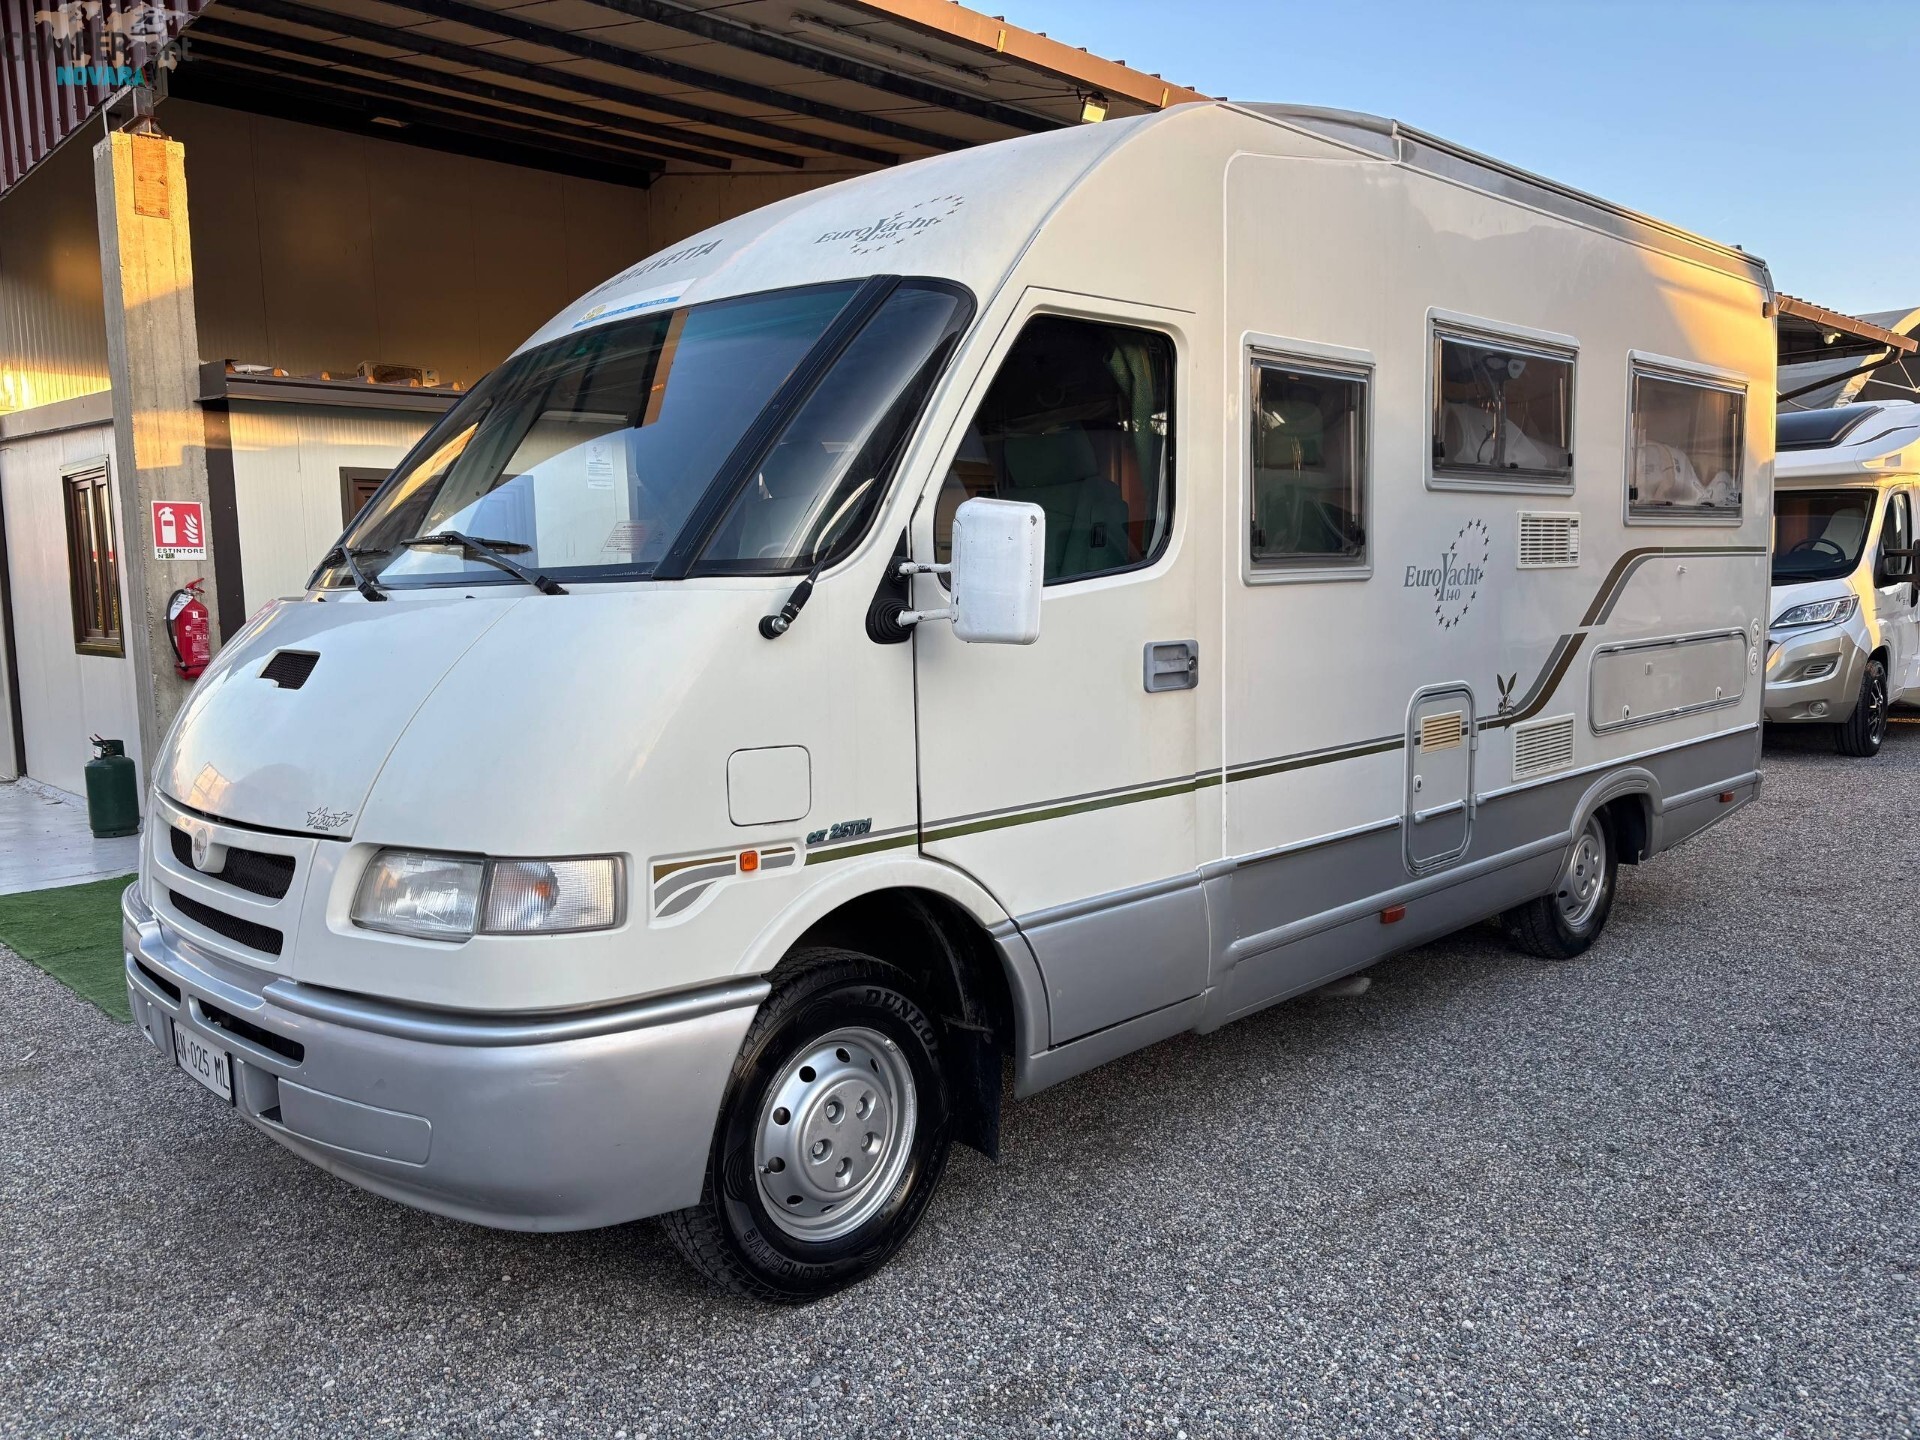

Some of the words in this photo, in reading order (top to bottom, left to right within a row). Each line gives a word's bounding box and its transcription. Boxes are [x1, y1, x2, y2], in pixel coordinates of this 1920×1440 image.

[1403, 553, 1481, 601] EuroYacht
[1445, 588, 1461, 601] 140
[865, 988, 940, 1050] DUNLO
[190, 1041, 210, 1078] 025
[214, 1055, 230, 1091] ML
